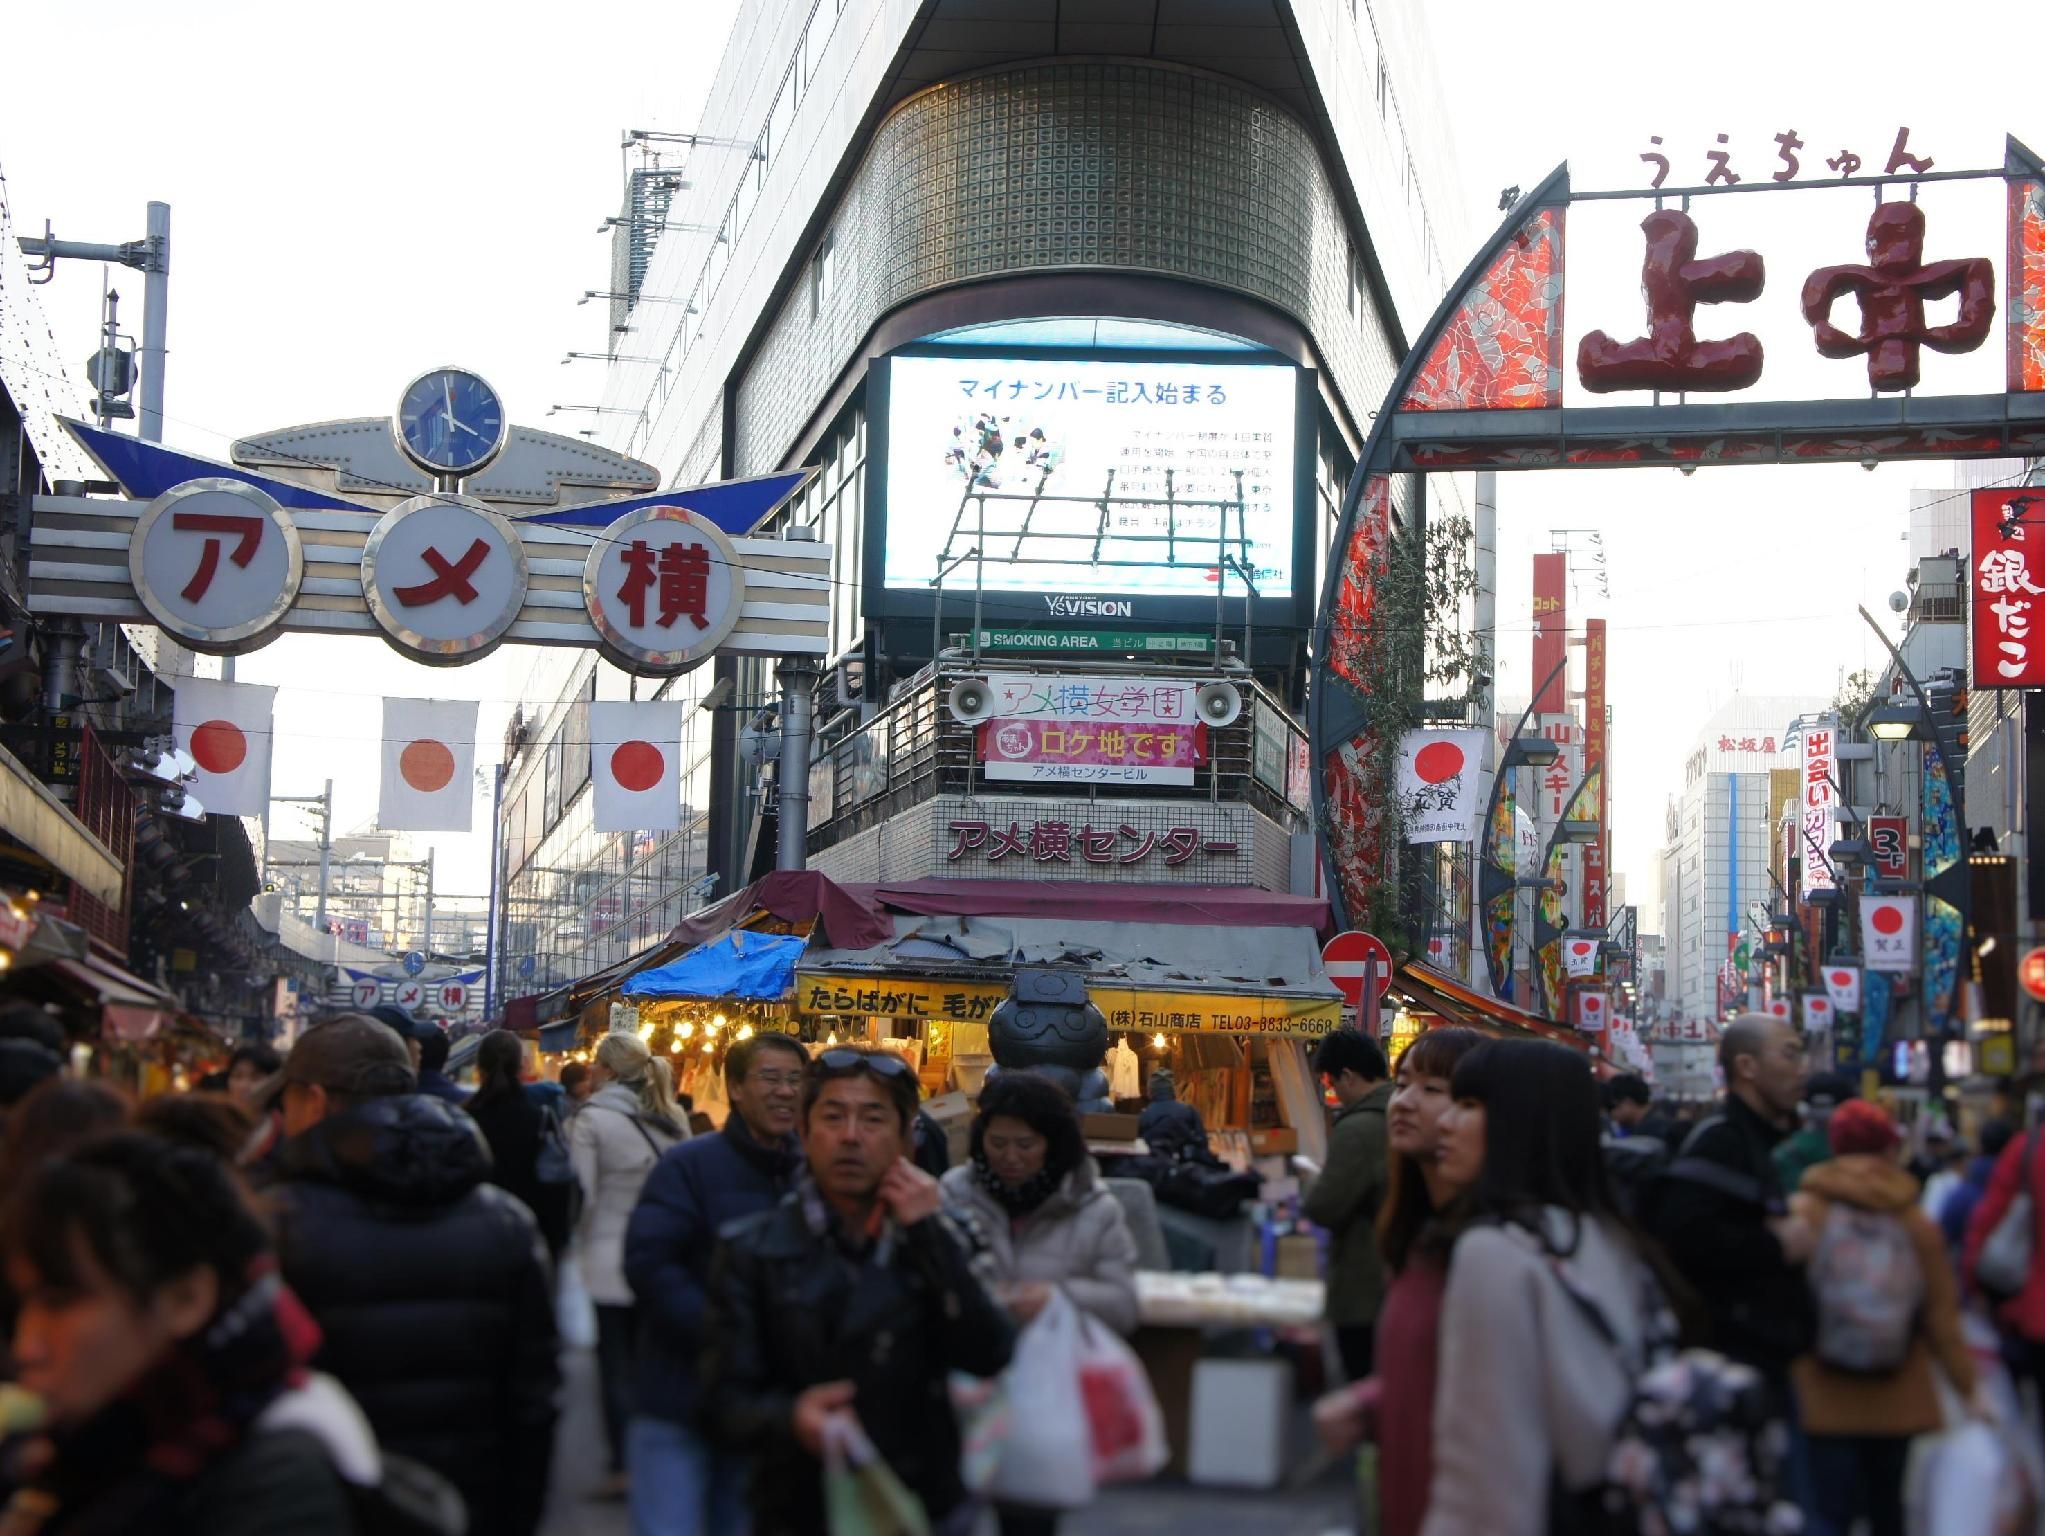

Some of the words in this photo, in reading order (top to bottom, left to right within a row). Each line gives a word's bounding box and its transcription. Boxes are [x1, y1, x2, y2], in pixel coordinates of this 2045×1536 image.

[1639, 126, 1935, 189] うえちゅん
[1576, 200, 1997, 394] 上中
[957, 379, 1228, 406] マイナンバー記入始まる
[173, 511, 712, 632] アメ横
[1978, 549, 2045, 679] 銀だこ
[993, 633, 1057, 648] SMOKING
[1060, 635, 1099, 648] AREA
[1001, 682, 1184, 719] アメ横女学園
[1040, 729, 1184, 759] ロケ地です
[1717, 734, 1777, 754] 松坂屋
[1032, 764, 1149, 781] アメ横センタービル
[948, 819, 1239, 865] アメ横センター
[808, 986, 930, 1017] たらばがに
